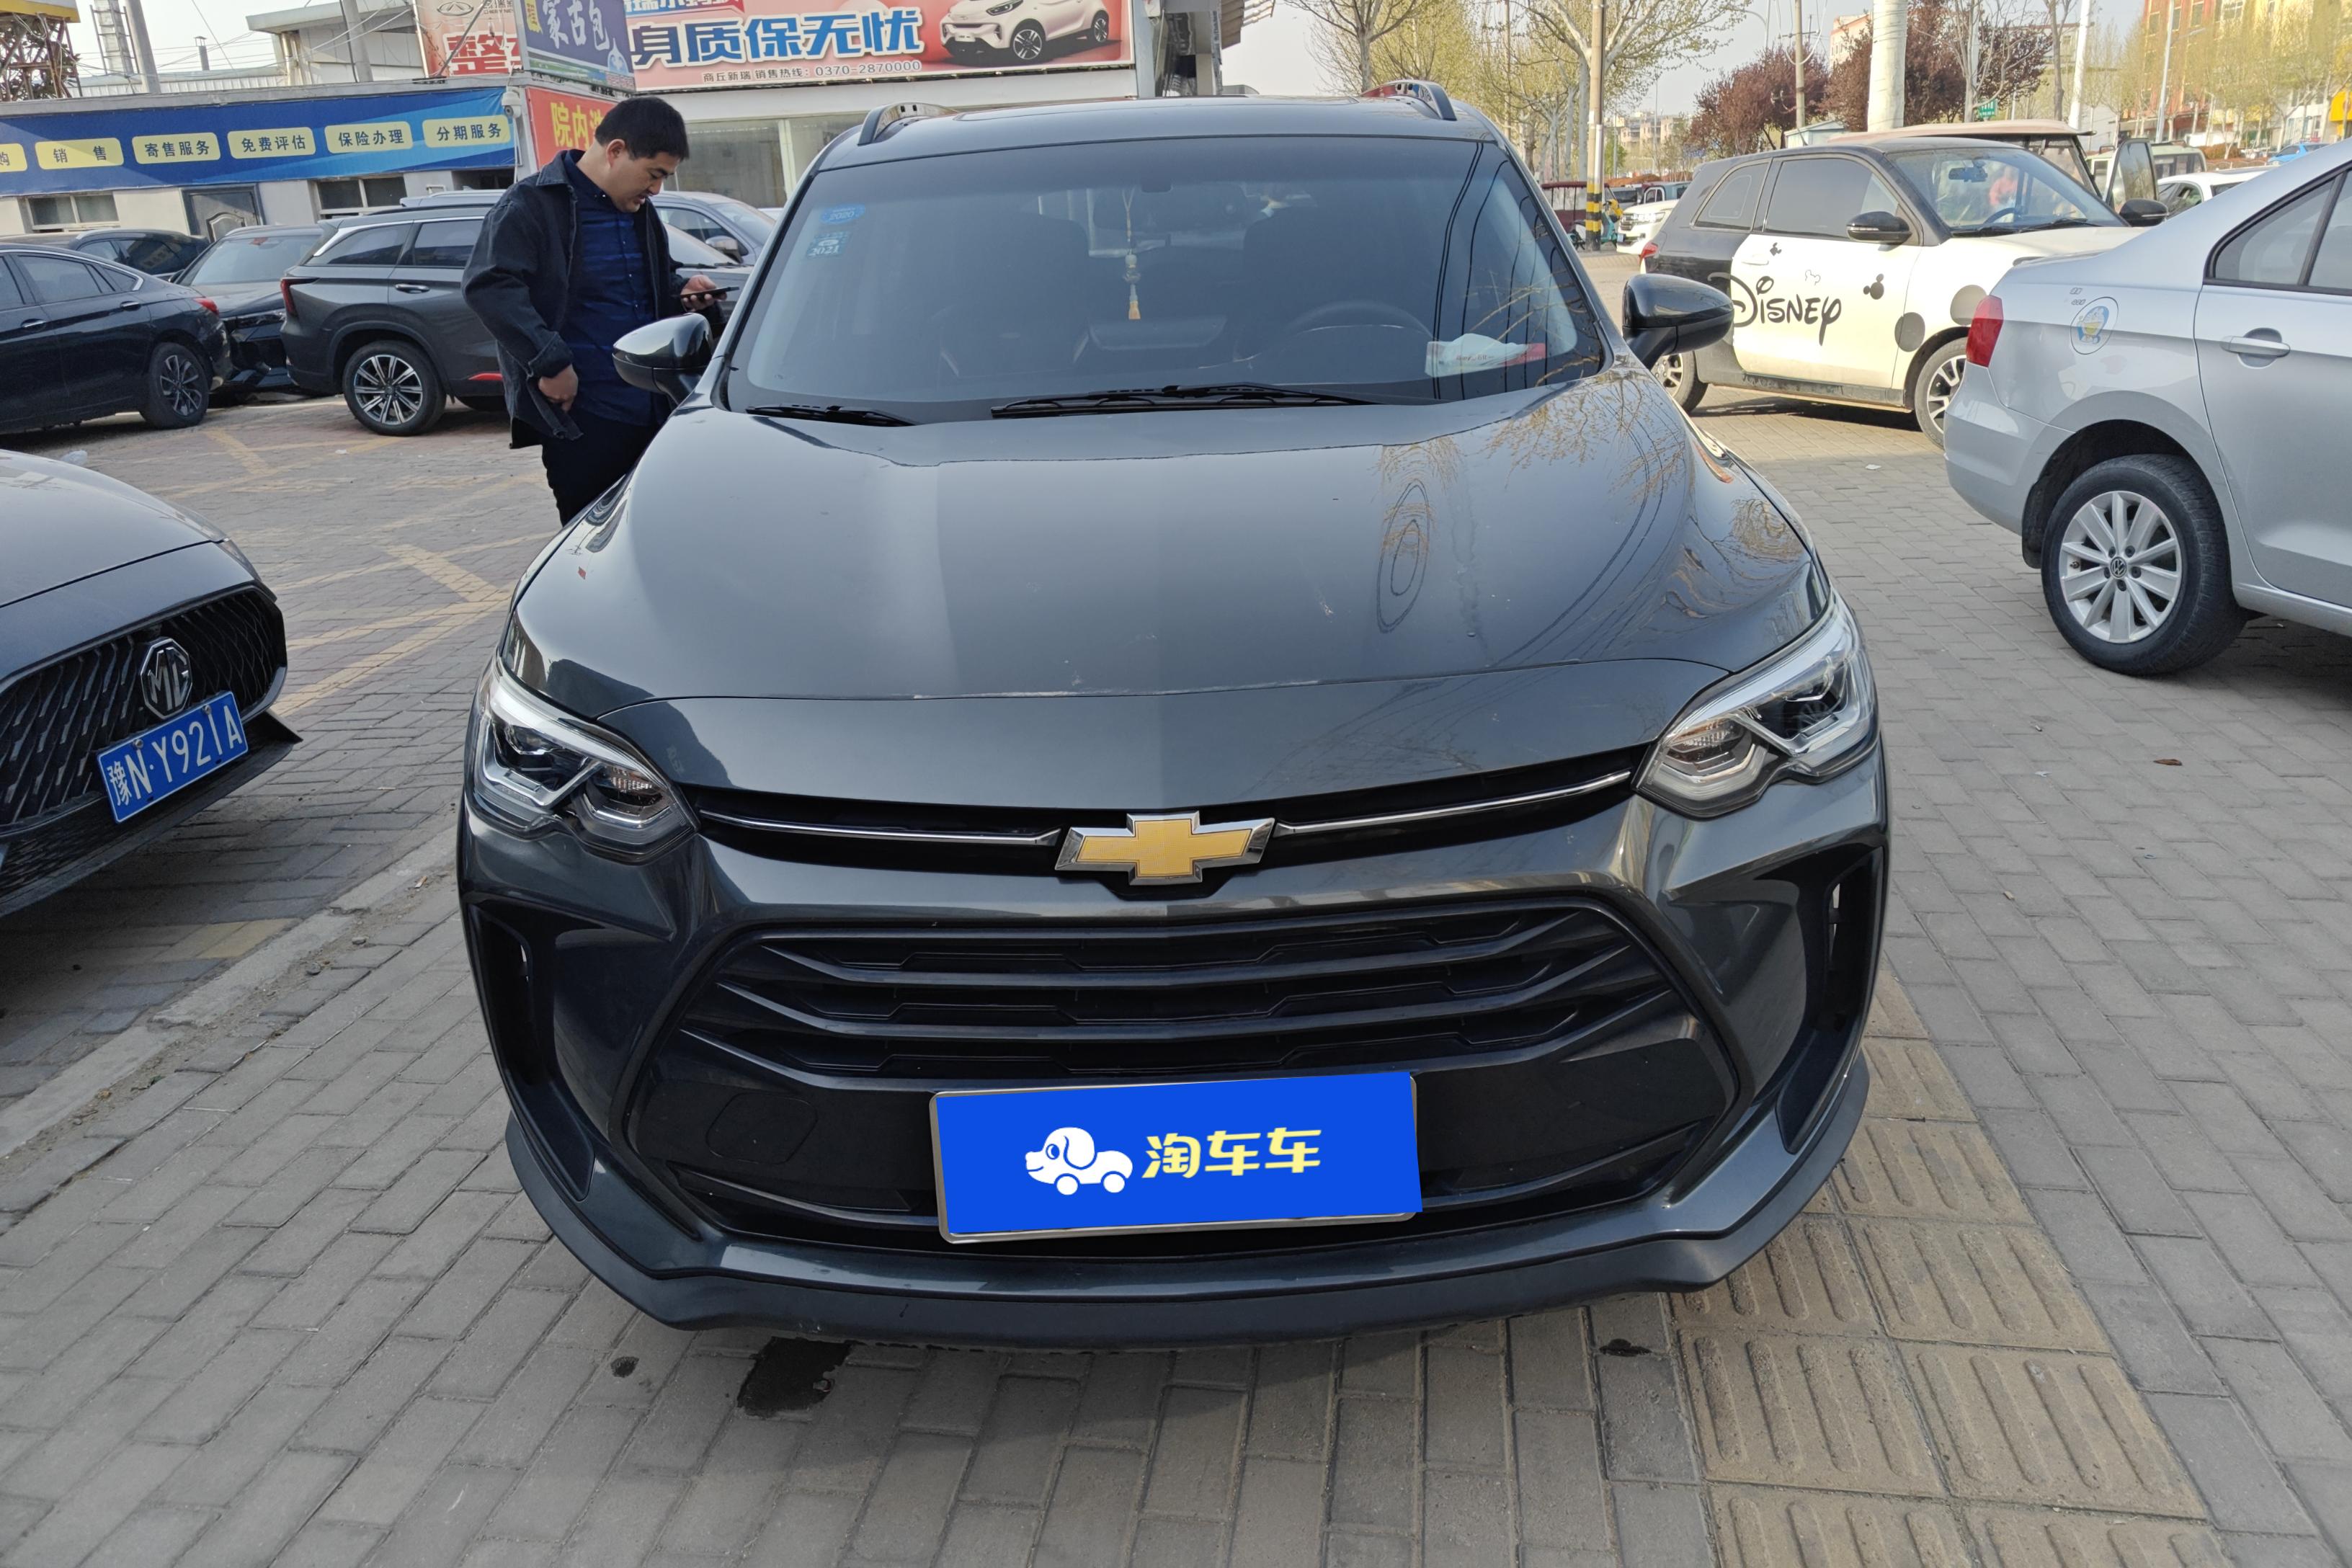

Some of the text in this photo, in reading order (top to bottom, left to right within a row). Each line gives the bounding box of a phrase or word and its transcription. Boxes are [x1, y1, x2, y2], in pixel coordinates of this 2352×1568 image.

[703, 70, 752, 83] 商丘新瑞
[815, 61, 921, 77] 0370-2870000
[436, 122, 503, 141] 分期服务
[550, 101, 604, 151] 院内
[241, 134, 307, 153] 免费评估
[338, 128, 405, 148] 保险办理
[144, 139, 210, 158] 寄售服务
[808, 245, 840, 257] 2021
